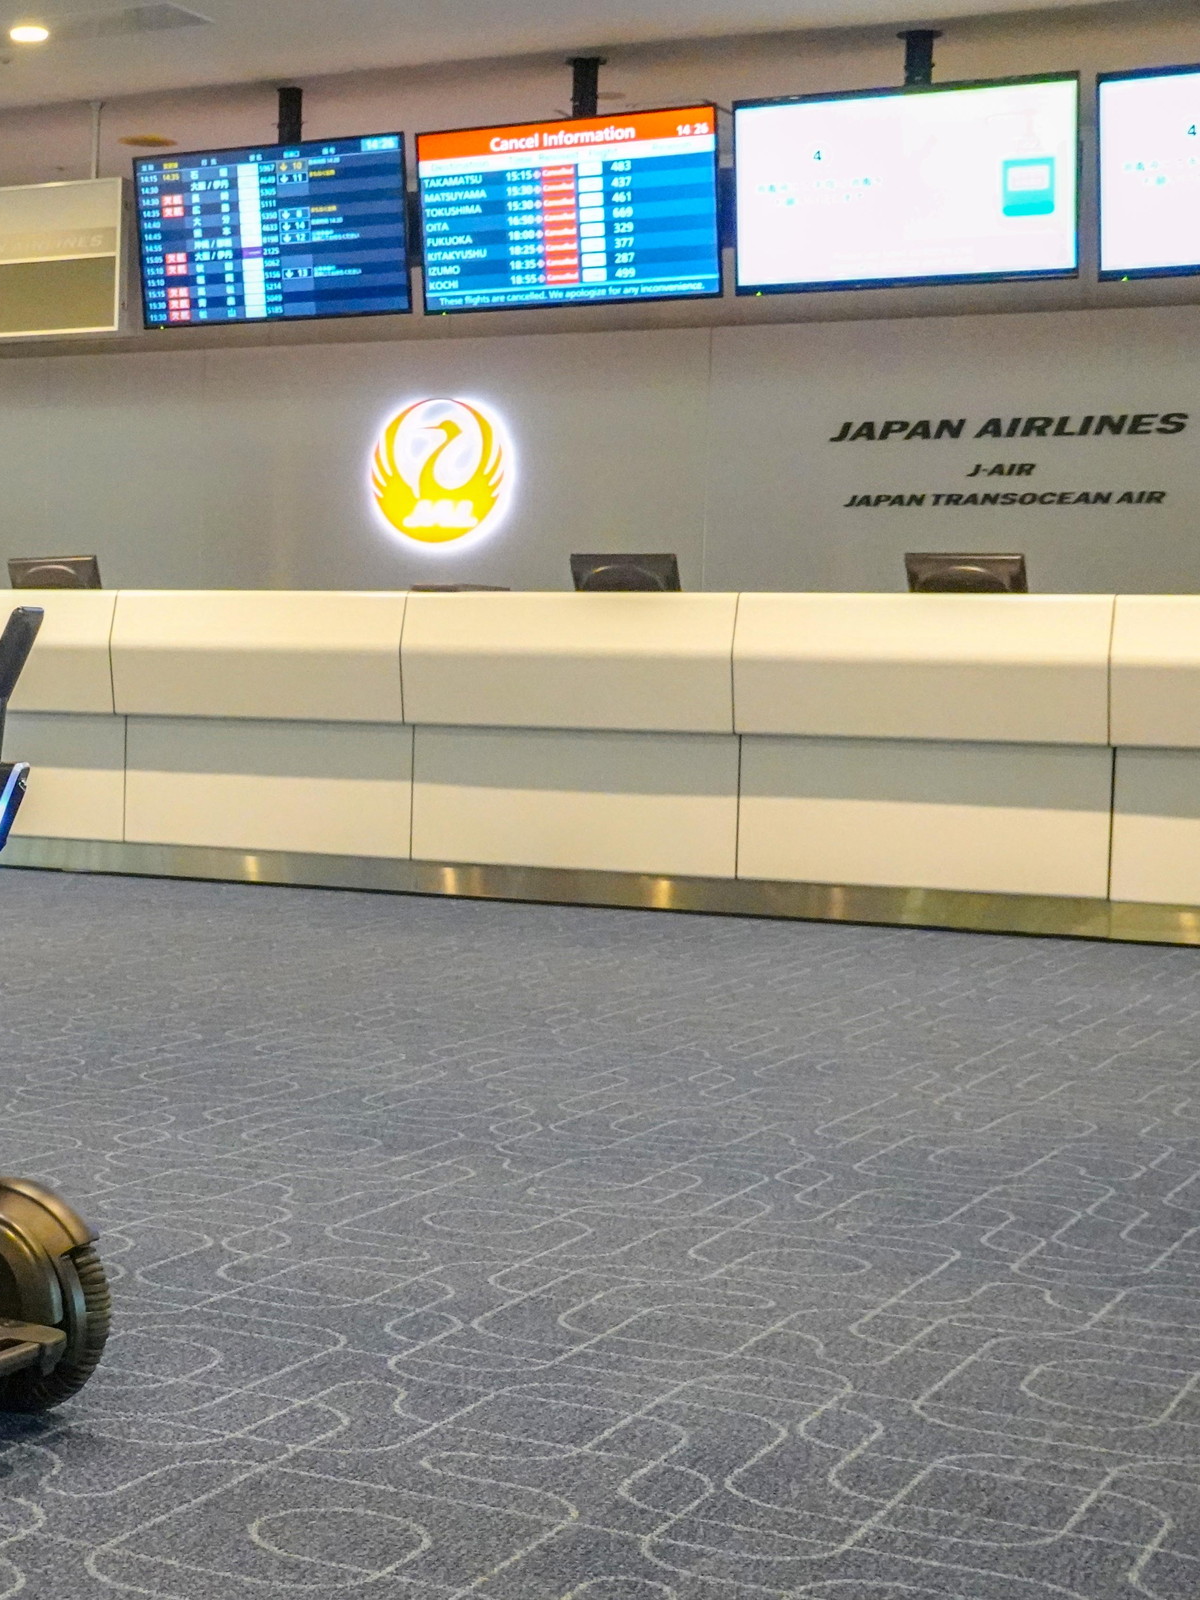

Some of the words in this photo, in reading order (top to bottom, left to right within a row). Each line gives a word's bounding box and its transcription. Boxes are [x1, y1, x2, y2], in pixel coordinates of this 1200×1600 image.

[489, 133, 540, 153] Cancel
[543, 124, 636, 149] Information
[293, 173, 302, 182] 11
[423, 174, 483, 188] TAKAMATSU
[424, 189, 487, 203] MATSUYAMA
[611, 175, 632, 188] 437
[425, 204, 482, 218] TOKUSHIMA
[295, 233, 306, 241] 12
[425, 222, 449, 233] OITA
[426, 234, 473, 247] FUKUOKA
[613, 222, 634, 234] 329
[427, 249, 487, 262] KITAKYUSHU
[614, 237, 635, 249] 377
[428, 265, 461, 276] IZUMO
[614, 252, 635, 264] 287
[429, 280, 459, 291] KOCHI
[615, 267, 636, 279] 499
[440, 296, 463, 307] These
[465, 294, 491, 306] flights
[492, 295, 506, 303] are
[549, 289, 563, 299] We
[564, 287, 607, 300] apologize
[608, 286, 621, 296] for
[623, 286, 639, 296] any
[829, 418, 967, 443] JAPAN
[973, 412, 1189, 439] AIRLINES
[965, 463, 1036, 478] J-AIR
[843, 494, 926, 508] JAPAN
[931, 490, 1113, 507] TRANSOCEAN
[1115, 490, 1167, 505] AIR
